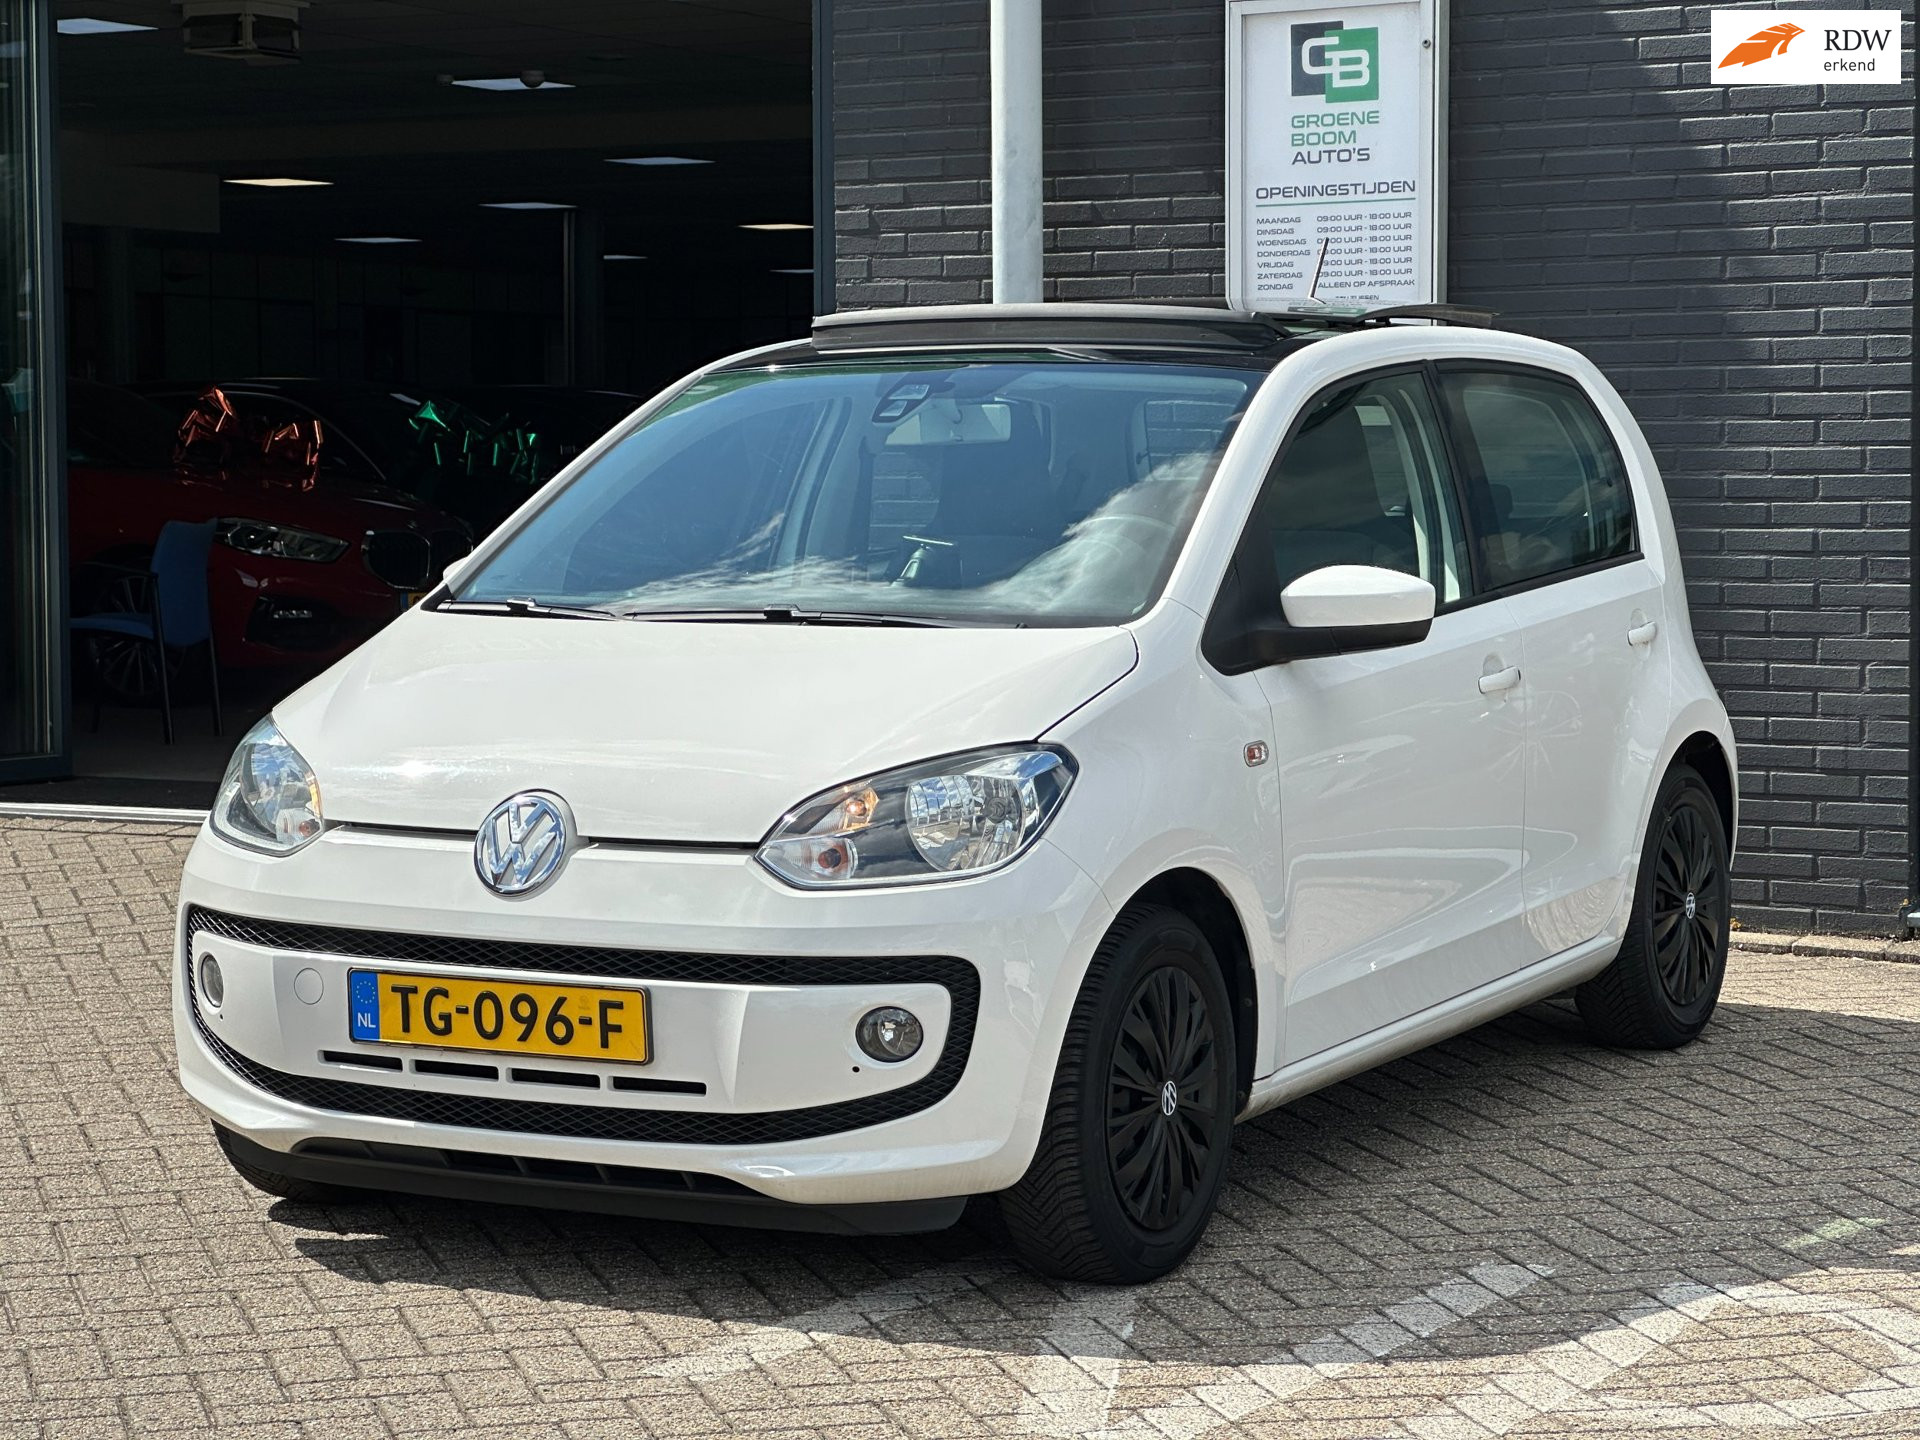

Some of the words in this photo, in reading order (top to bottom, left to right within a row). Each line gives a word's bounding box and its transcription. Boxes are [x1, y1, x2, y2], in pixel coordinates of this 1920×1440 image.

[1291, 110, 1380, 129] GROENE
[1291, 130, 1357, 147] BOOM
[1291, 147, 1370, 165] AUTO'S
[1255, 180, 1416, 200] OPENINGSTIJDEN
[1256, 216, 1302, 224] MAANDAG
[1256, 228, 1294, 236] DINSDAG
[1256, 238, 1307, 246] WOENSDAG
[1257, 250, 1310, 258] DONDERDAG
[1258, 272, 1303, 280] ZATERDAG
[1318, 281, 1351, 289] ALLEEN
[1368, 279, 1415, 287] AFSPRAAK
[357, 1012, 377, 1029] NL
[390, 983, 624, 1049] TG-096-F
